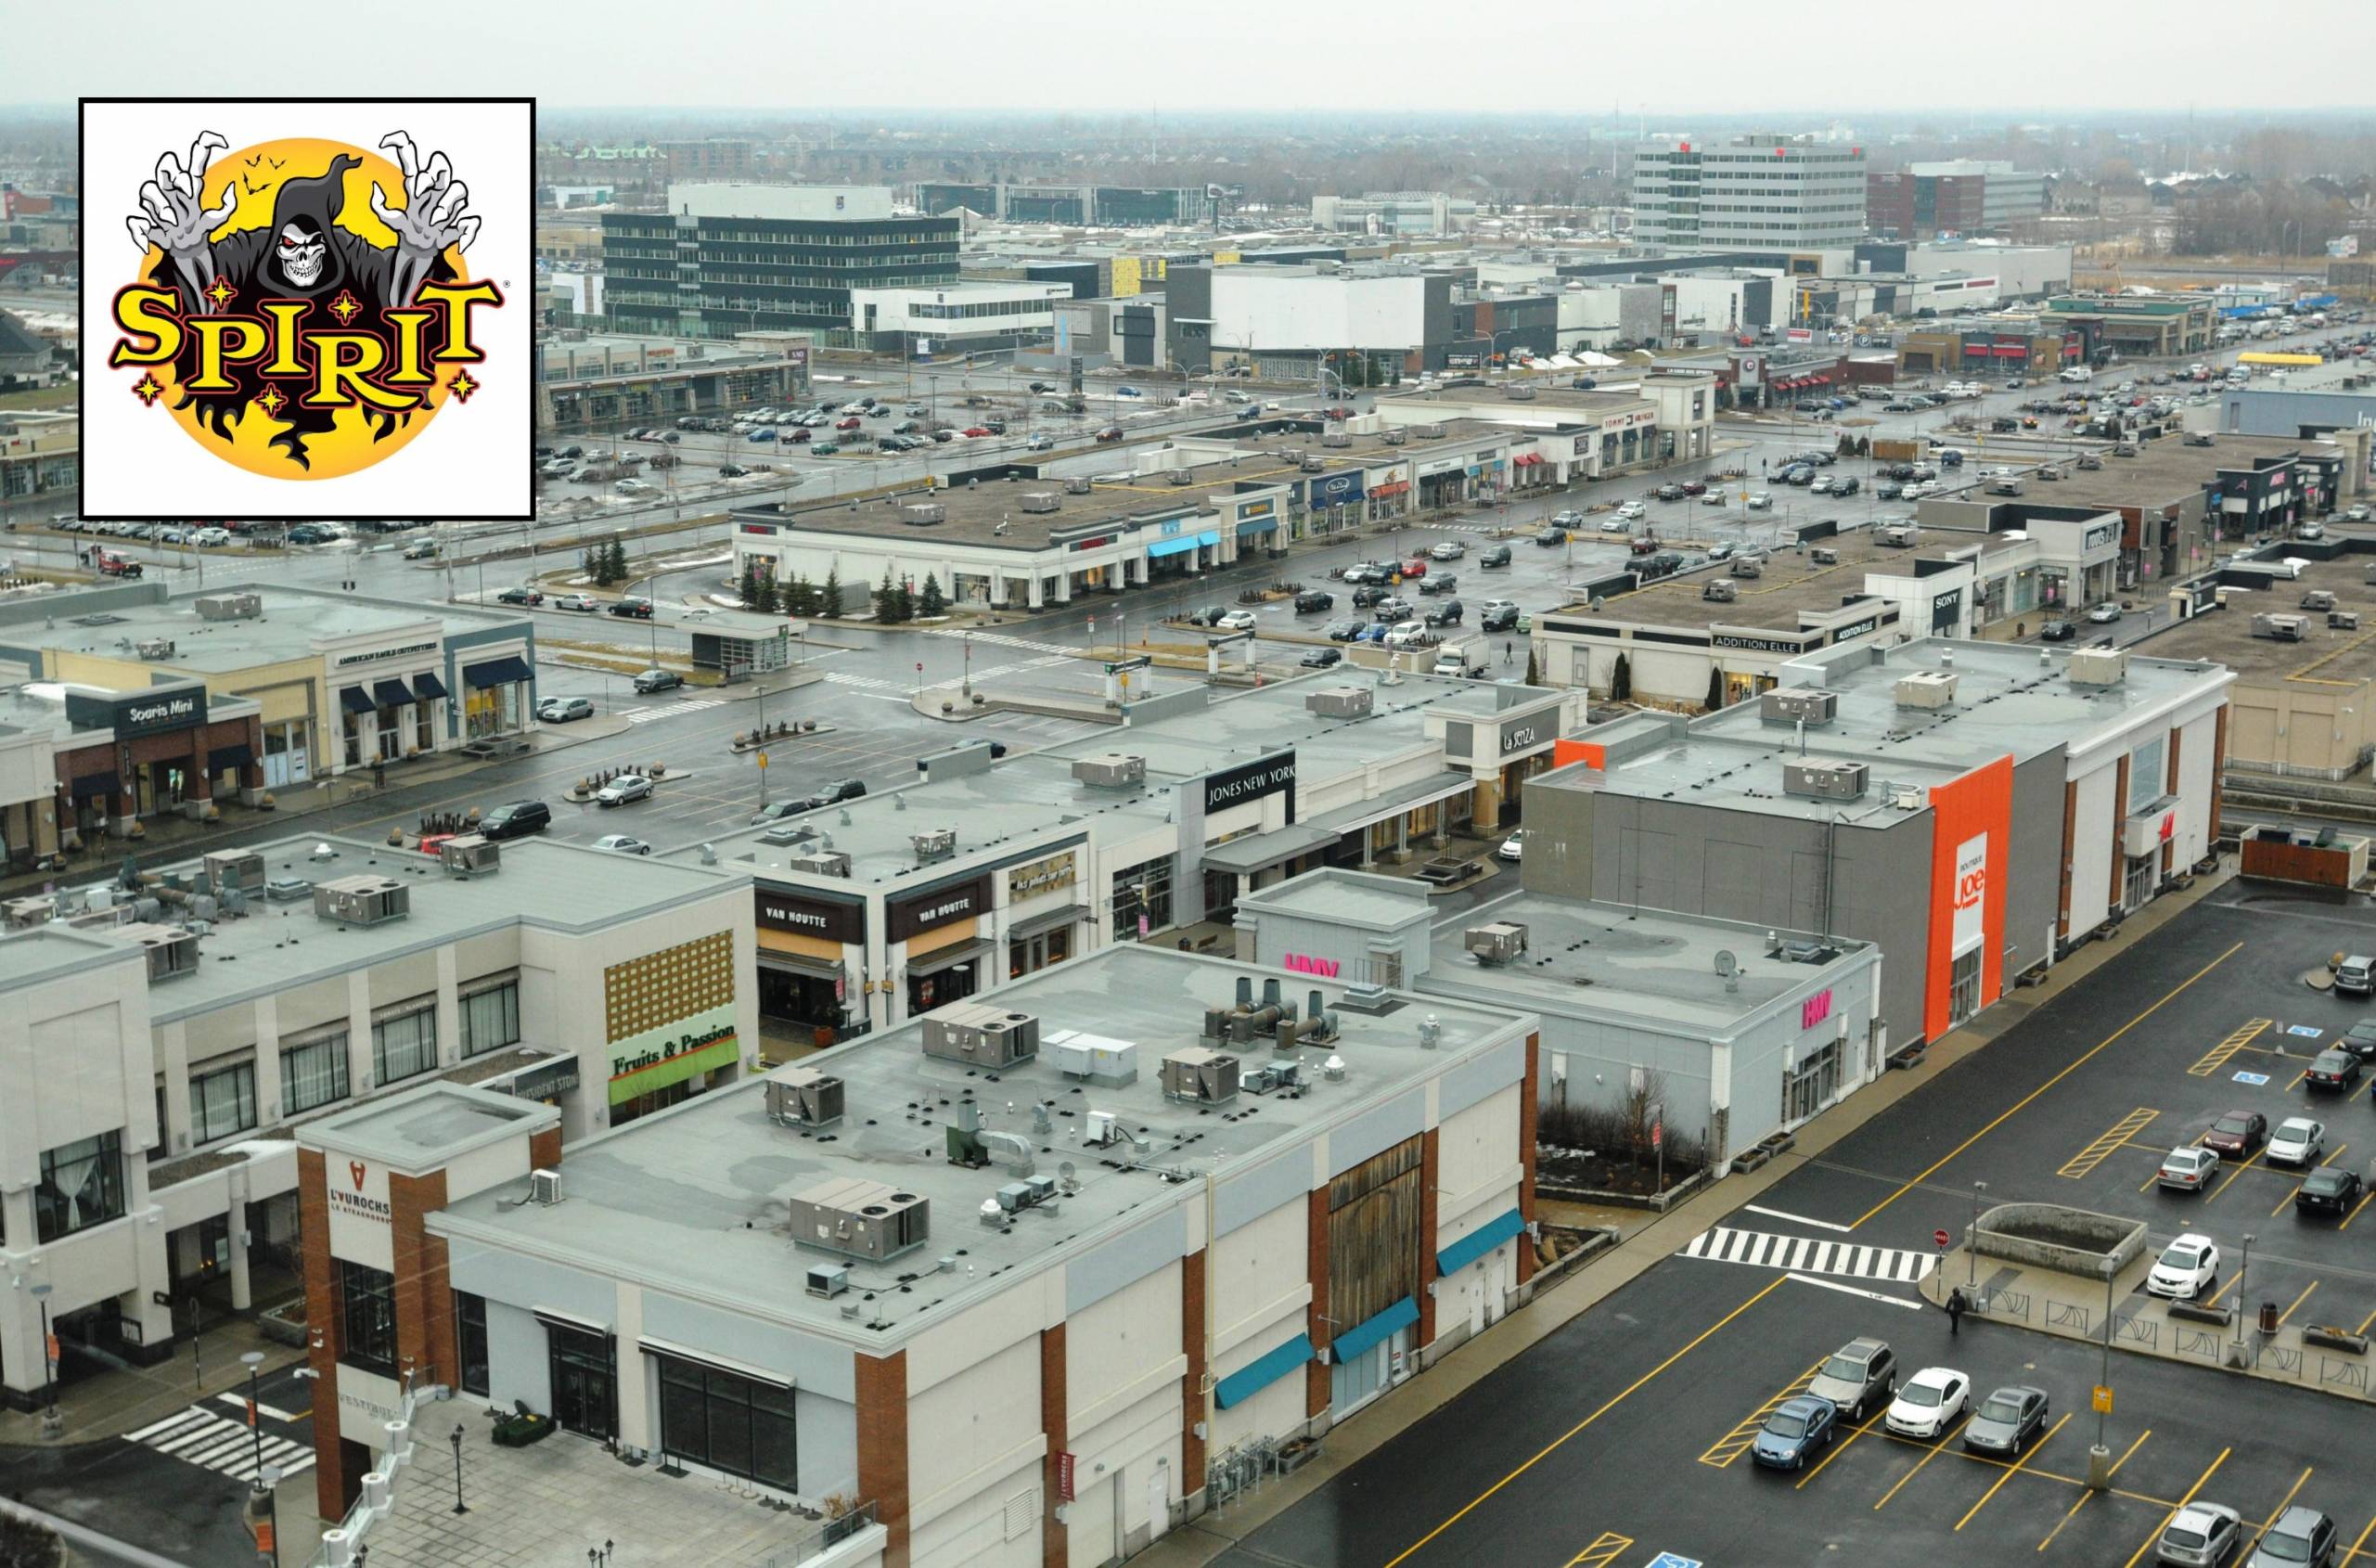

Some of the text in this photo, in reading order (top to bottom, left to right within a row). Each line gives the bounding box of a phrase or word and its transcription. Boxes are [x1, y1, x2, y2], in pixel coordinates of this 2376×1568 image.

[1935, 592, 1959, 609] SONY
[1839, 621, 1873, 639] ADDITION ELLE
[1715, 636, 1796, 653] ADDITION ELLE
[339, 653, 374, 665] AMERICAN
[375, 649, 396, 660] EAGLE
[170, 698, 193, 714] Mini
[1209, 764, 1295, 806] JONES NEW YORK
[765, 906, 827, 928] VAN HOUTTE
[918, 898, 970, 922] VAN HOUTTE
[1803, 988, 1832, 1031] HMV
[613, 1024, 735, 1075] Fruits & Passion
